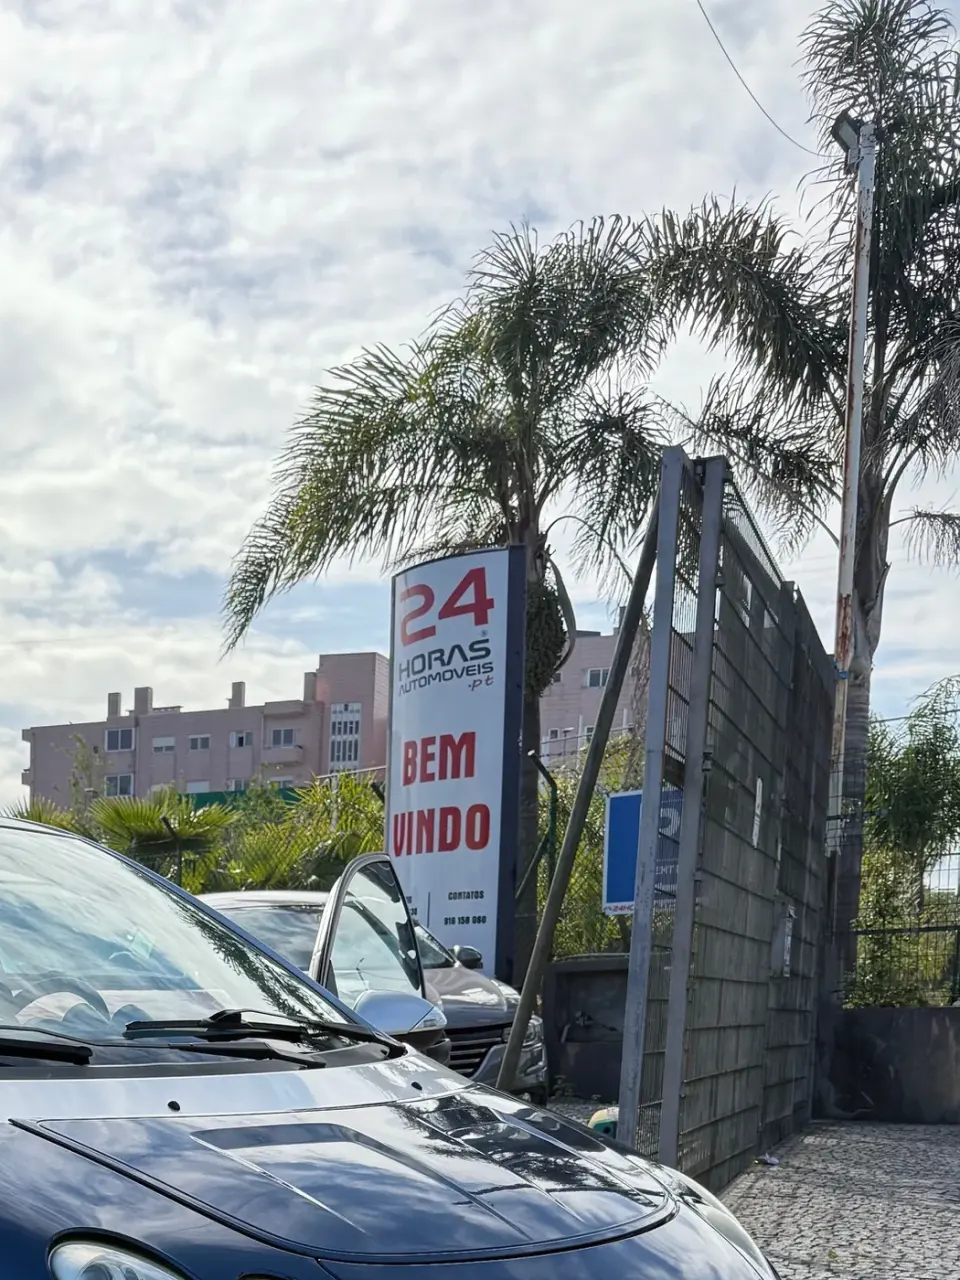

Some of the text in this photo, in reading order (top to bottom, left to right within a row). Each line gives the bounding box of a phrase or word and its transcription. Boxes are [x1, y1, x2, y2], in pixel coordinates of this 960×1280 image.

[400, 567, 494, 647] 24
[398, 662, 494, 697] AUTOMOVEIS
[399, 639, 491, 682] HORAS
[402, 732, 476, 786] BEM
[393, 804, 490, 857] VINDO
[448, 890, 484, 900] CONTATOS
